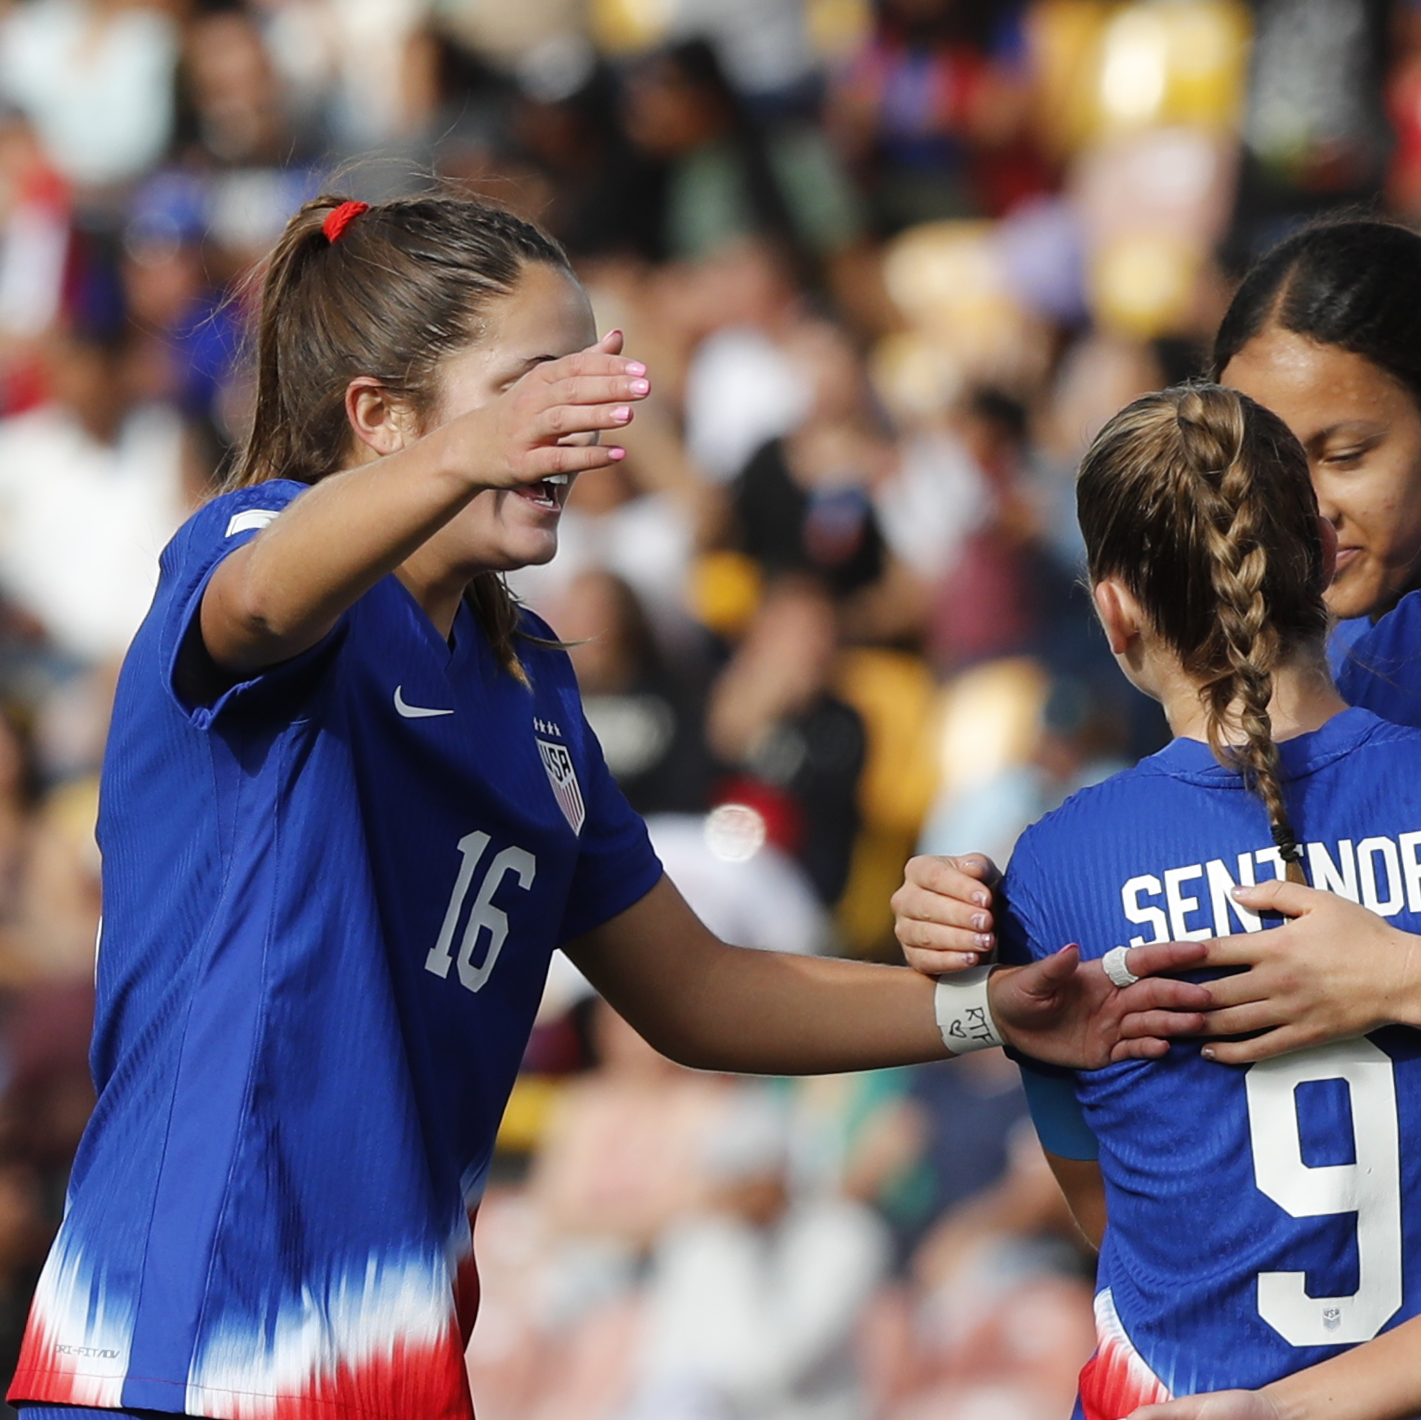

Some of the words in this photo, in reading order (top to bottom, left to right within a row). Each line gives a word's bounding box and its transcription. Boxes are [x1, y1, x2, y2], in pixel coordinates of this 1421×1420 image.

[539, 743, 572, 783] USA
[424, 830, 537, 993] 16
[1244, 1033, 1403, 1347] 9
